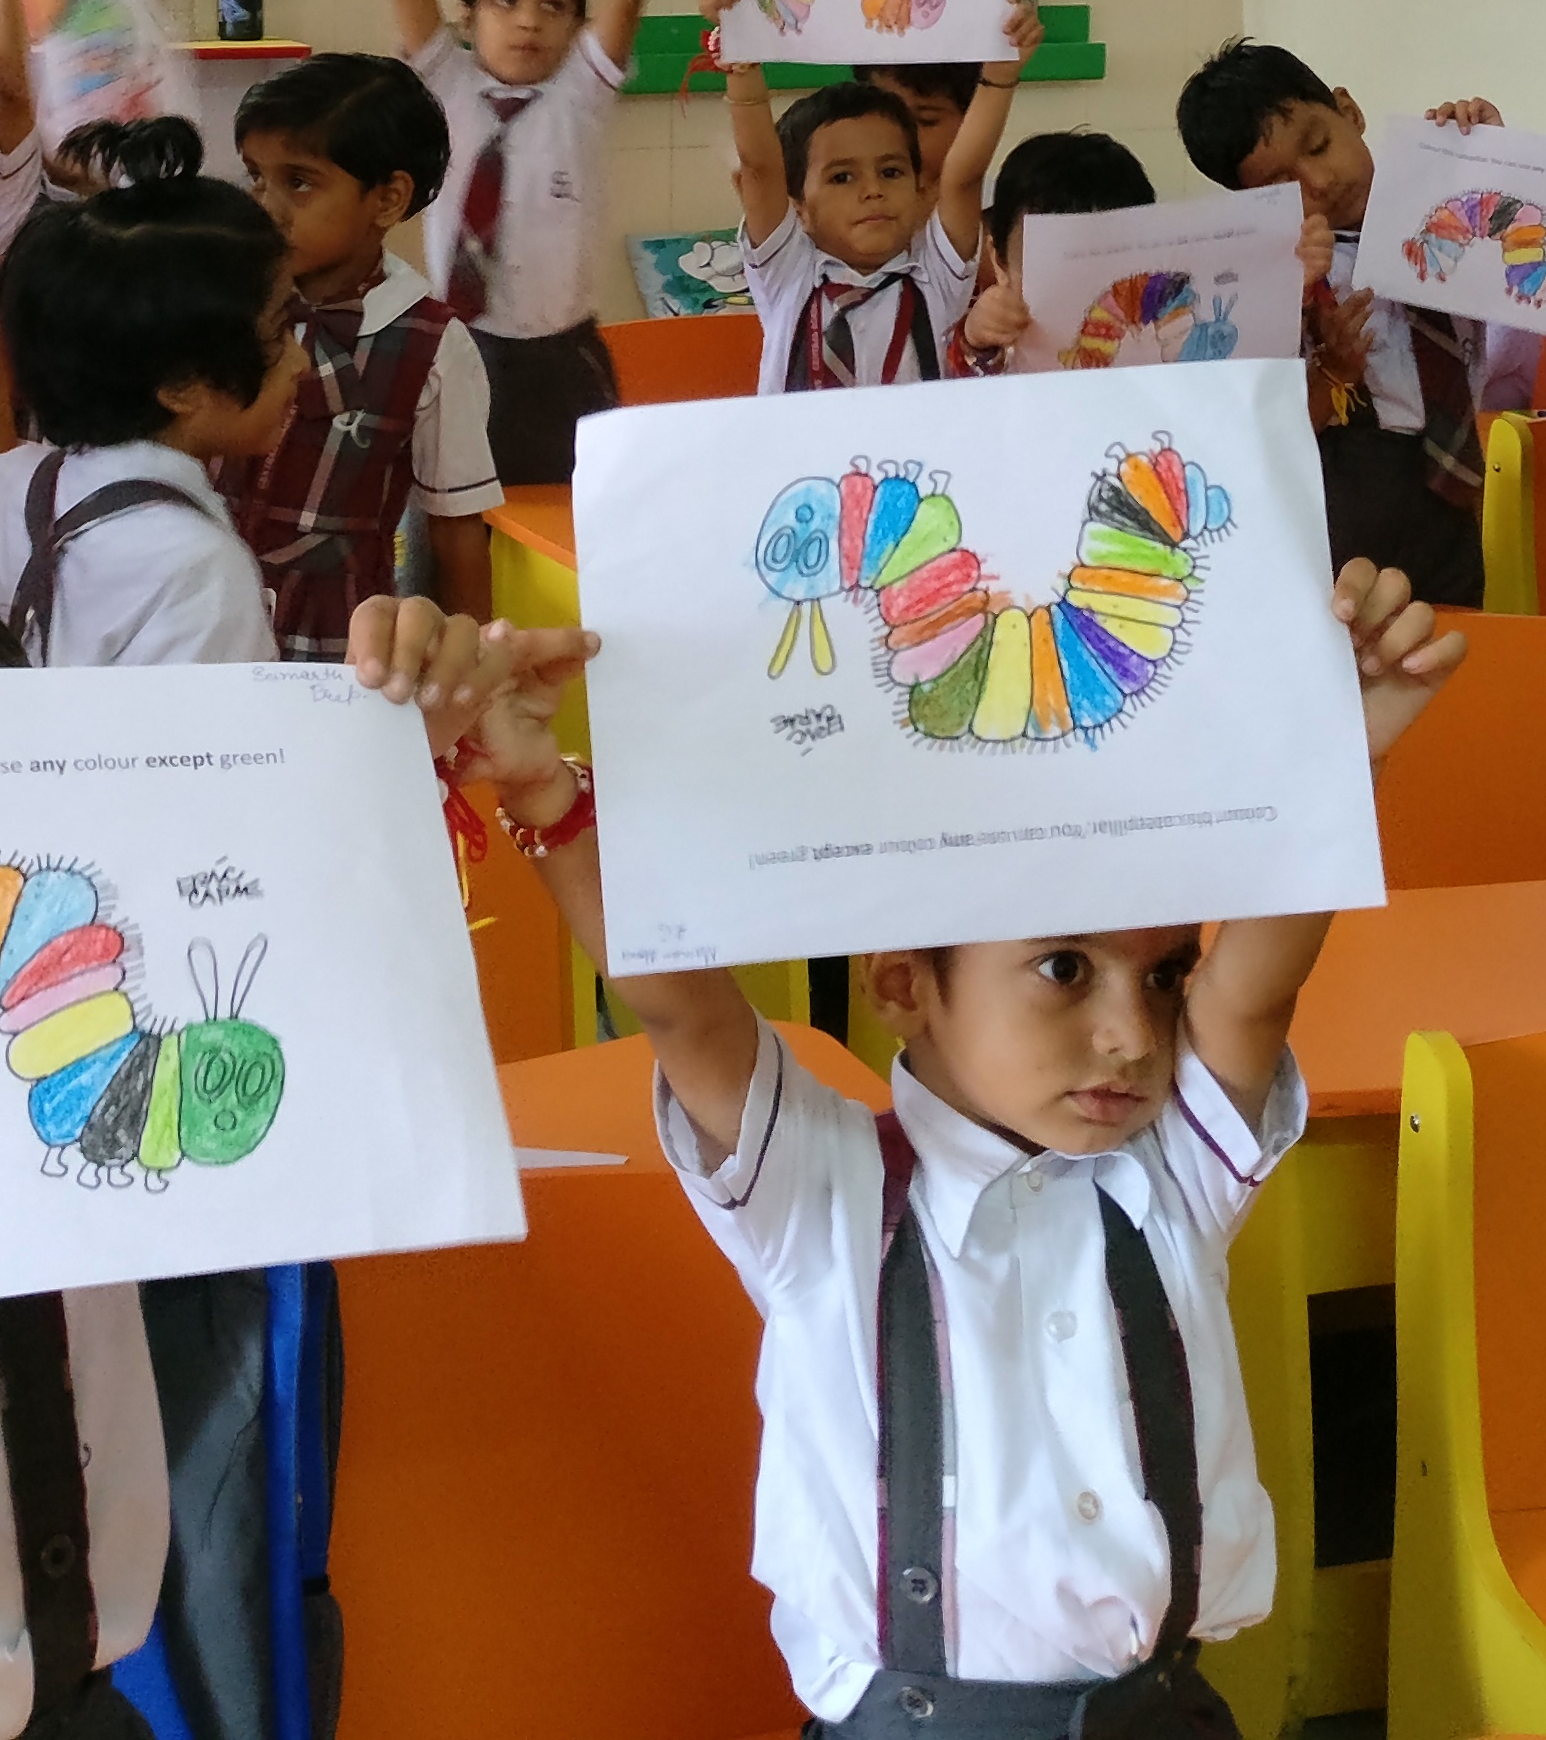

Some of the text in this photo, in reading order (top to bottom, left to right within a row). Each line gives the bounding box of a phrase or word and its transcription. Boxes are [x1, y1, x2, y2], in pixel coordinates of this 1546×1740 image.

[29, 757, 66, 776] any
[73, 753, 139, 772] colour
[145, 750, 214, 770] except
[219, 748, 286, 771] green!
